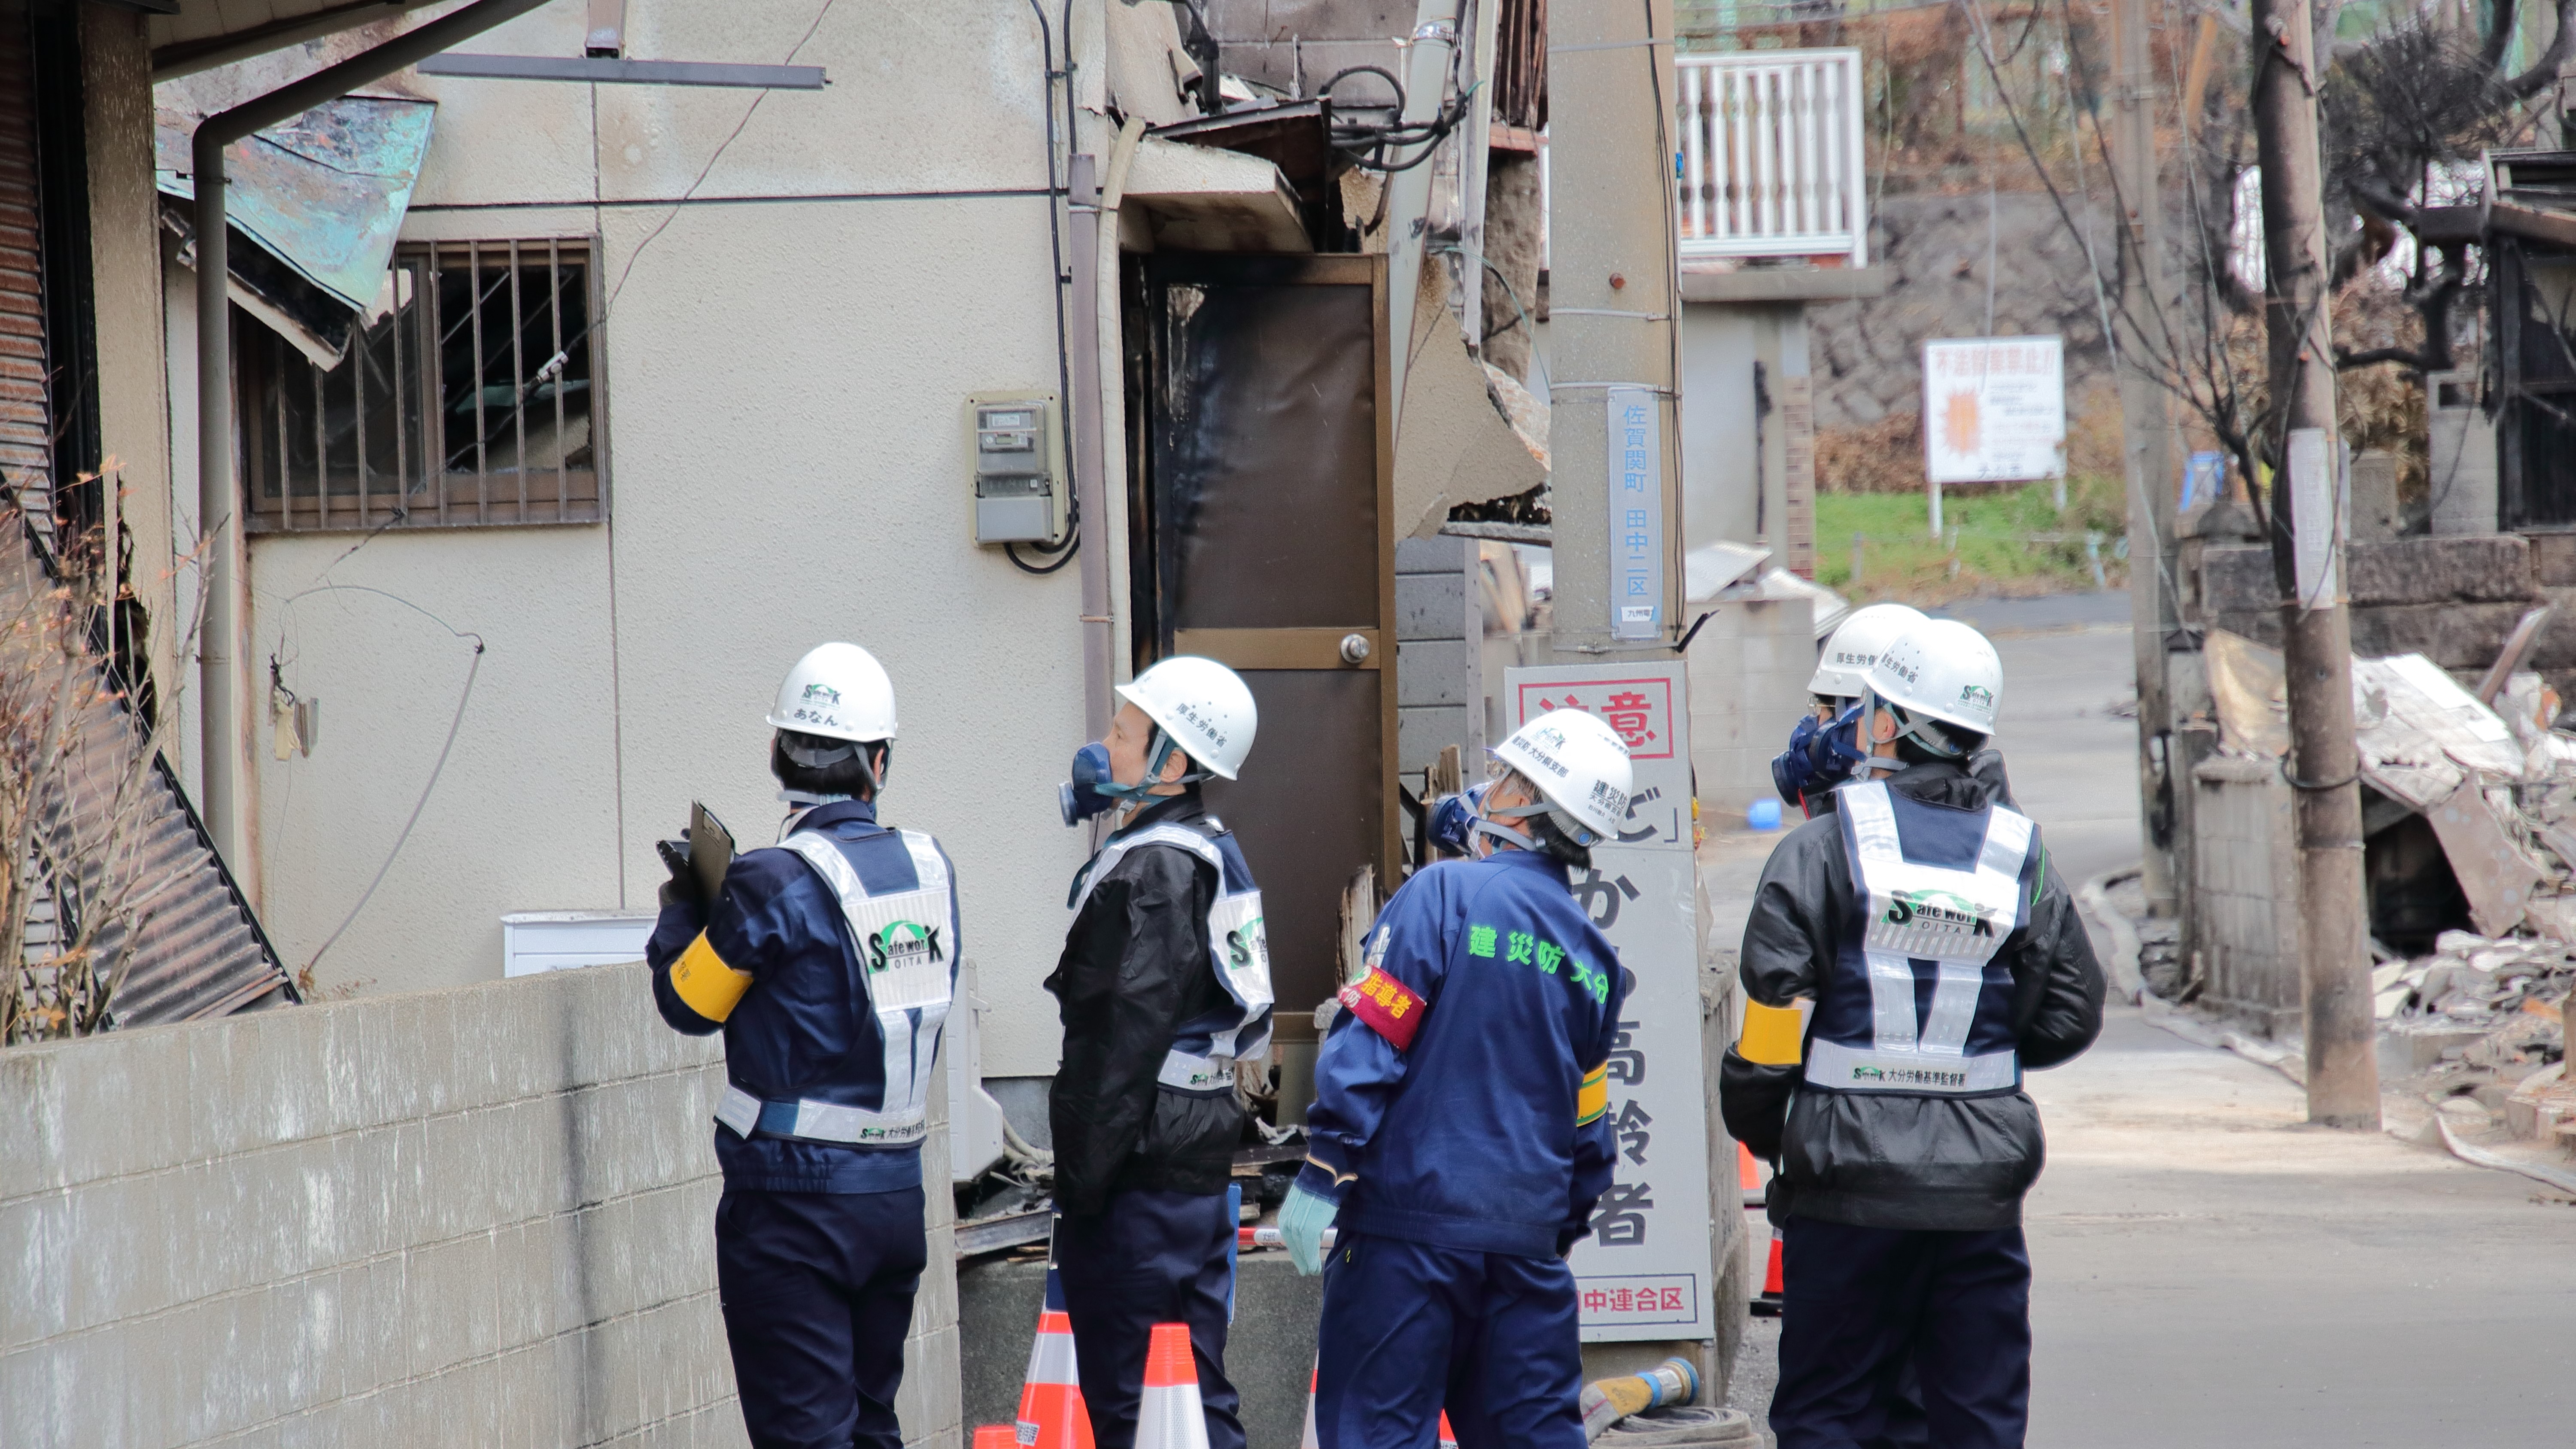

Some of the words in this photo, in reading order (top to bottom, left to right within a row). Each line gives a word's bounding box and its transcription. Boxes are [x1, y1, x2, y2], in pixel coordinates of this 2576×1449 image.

[1624, 405, 1647, 492] 佐賀関町
[1625, 509, 1648, 596] 田中二区
[793, 708, 838, 726] あなん
[1176, 703, 1227, 748] 厚生労働省
[1512, 735, 1531, 752] 建災防
[1528, 747, 1570, 778] 大分県支部
[1589, 794, 1622, 817] 大分県支部
[1593, 779, 1628, 809] 建災防
[1889, 890, 1943, 925] Safe
[1922, 921, 1962, 934] OITA
[869, 932, 905, 972] Safe
[894, 956, 922, 969] OITA
[1469, 926, 1565, 975] 建災防
[1570, 959, 1610, 1005] 大分
[1361, 972, 1412, 1019] 指導者
[1889, 1067, 1966, 1087] 大分労働基準監督署
[1577, 1287, 1684, 1313] 中連合区
